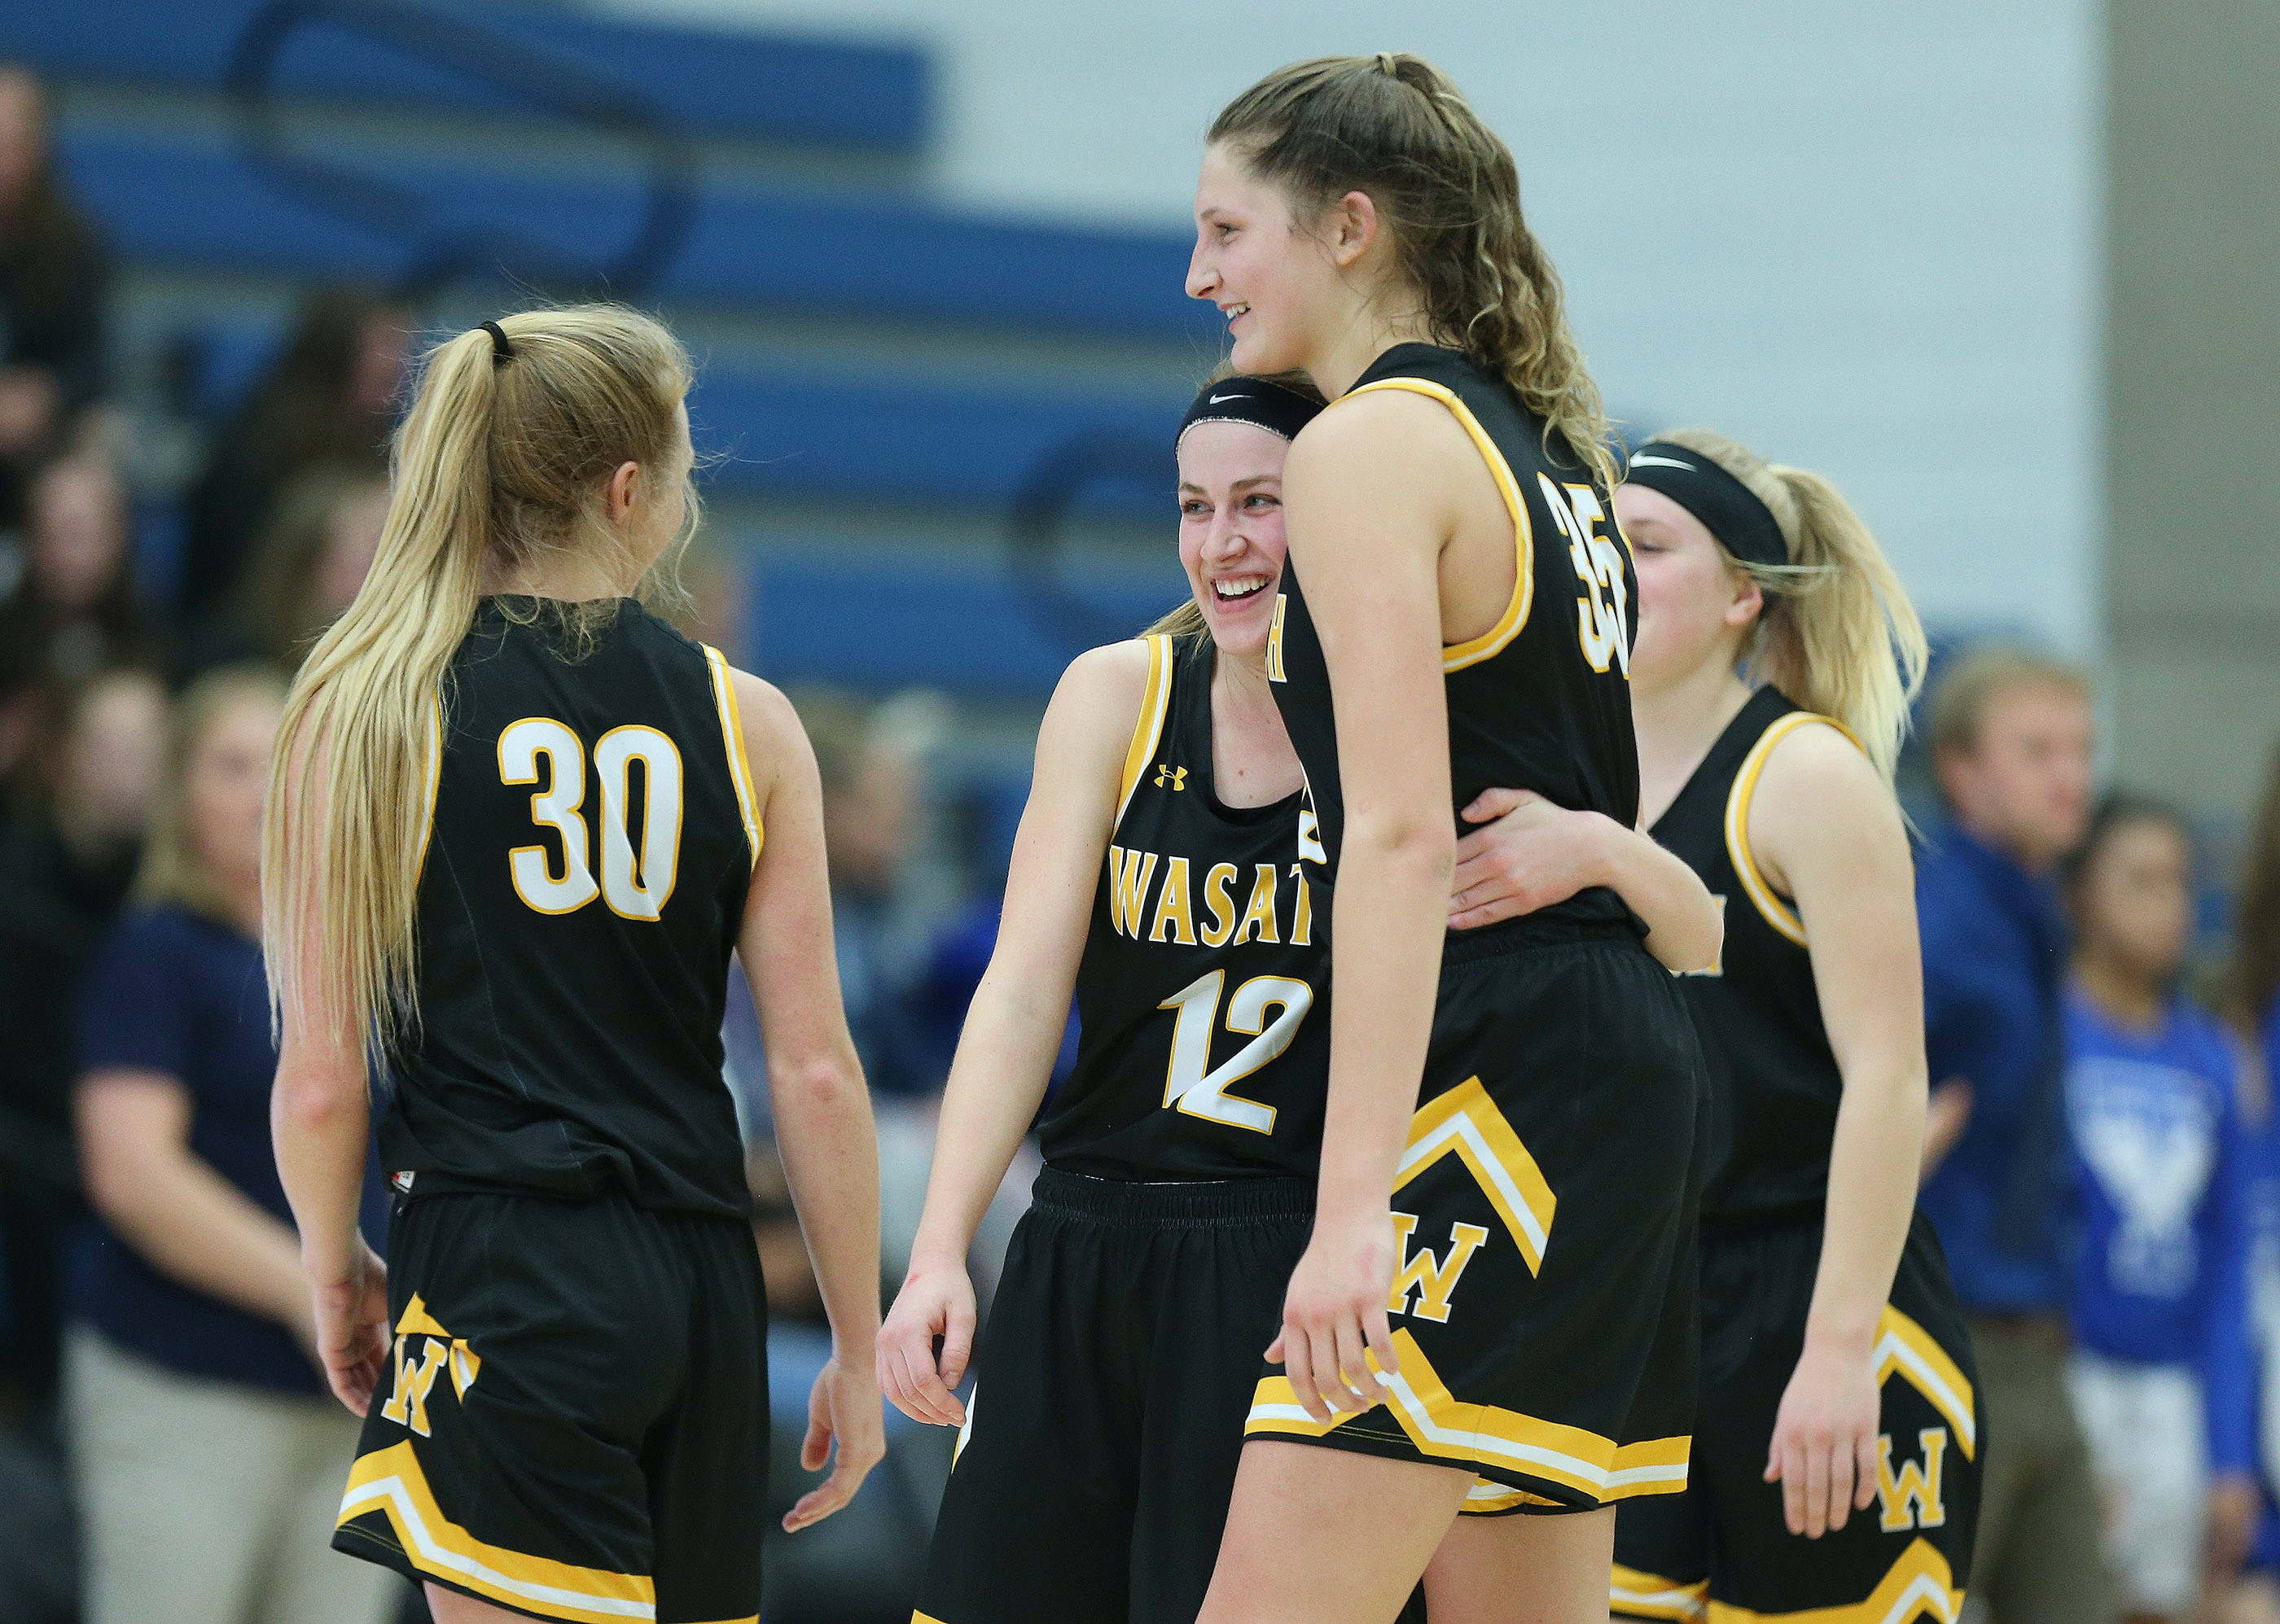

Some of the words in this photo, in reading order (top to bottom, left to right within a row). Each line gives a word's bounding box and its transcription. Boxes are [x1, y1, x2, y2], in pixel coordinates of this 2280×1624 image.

[1536, 471, 1629, 681] 35
[496, 716, 684, 922] 30
[1156, 968, 1314, 1136] 12
[1388, 1210, 1489, 1324] W
[380, 1333, 449, 1438] W
[1877, 1427, 1948, 1534] W
